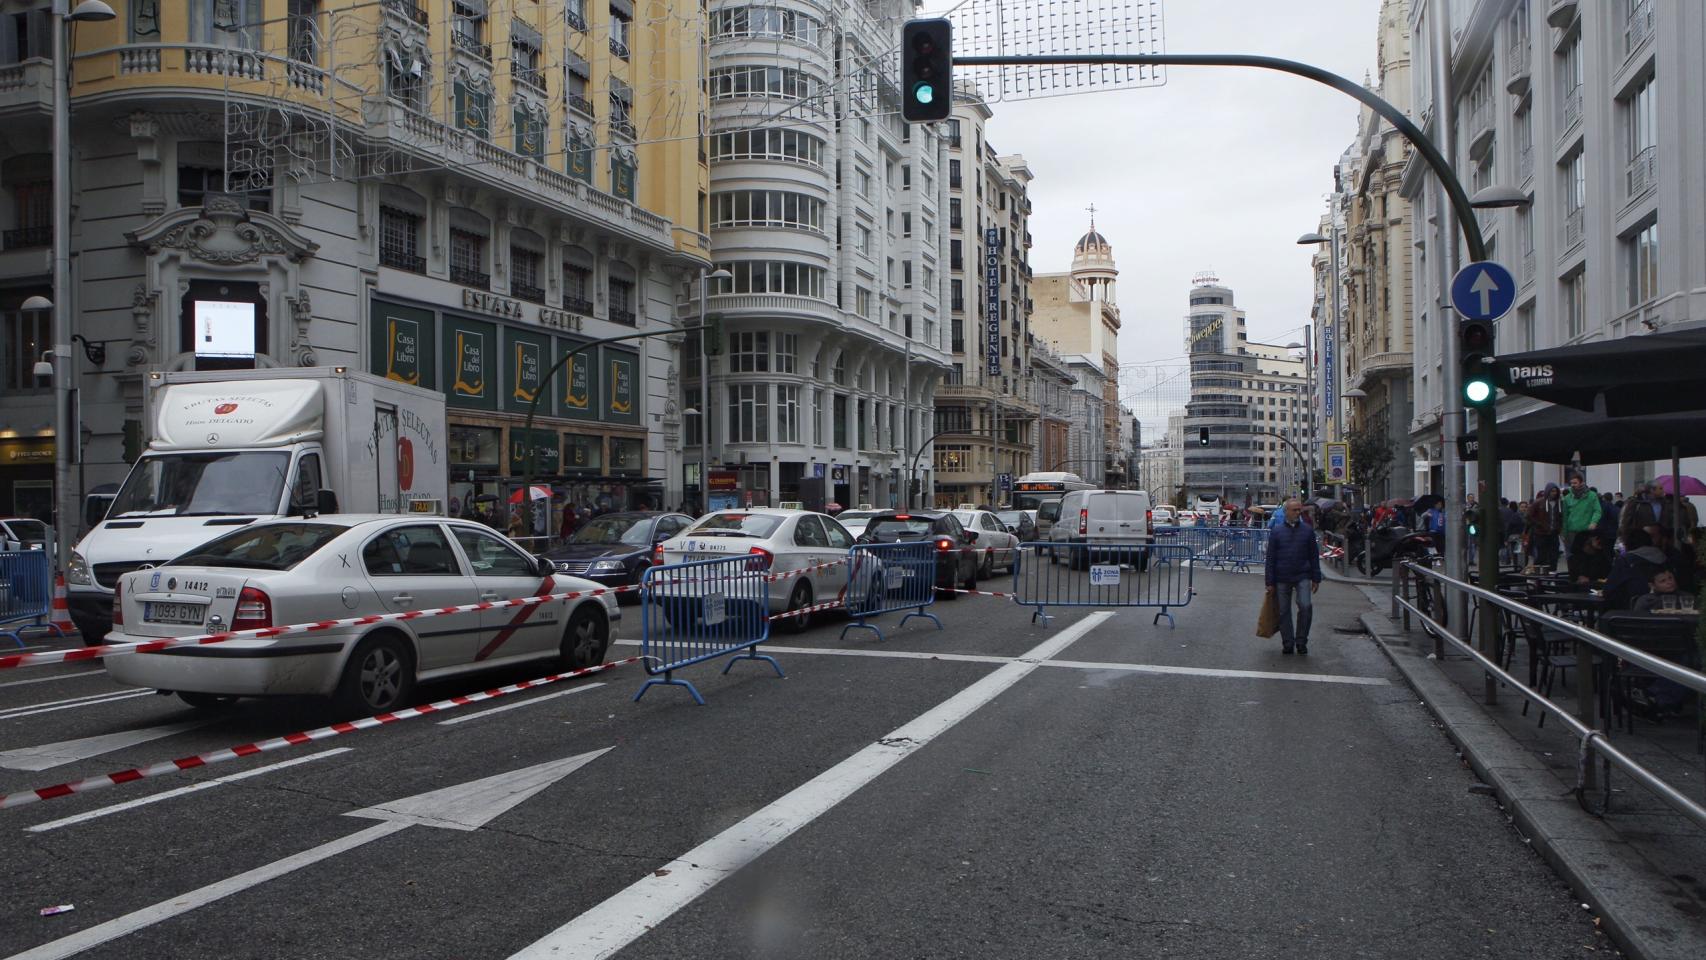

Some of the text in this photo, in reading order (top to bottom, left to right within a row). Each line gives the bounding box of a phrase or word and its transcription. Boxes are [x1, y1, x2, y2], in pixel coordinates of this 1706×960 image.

[462, 288, 584, 331] ESPASA CALPE
[988, 246, 998, 374] HOTEL REGENTE
[397, 333, 414, 345] Casa
[405, 345, 415, 354] del
[464, 344, 480, 356] Casa
[396, 352, 415, 363] Libro
[471, 356, 480, 364] del
[522, 354, 536, 364] Casa
[464, 361, 480, 372] Libro
[522, 370, 536, 381] Libro
[1509, 364, 1553, 383] pans
[230, 396, 273, 408] SELECTAS
[401, 409, 438, 465] SELECTAS
[1465, 440, 1478, 454] pa
[415, 502, 429, 513] TAXI
[184, 580, 209, 591] 14412
[154, 604, 200, 620] 1093 GYN
